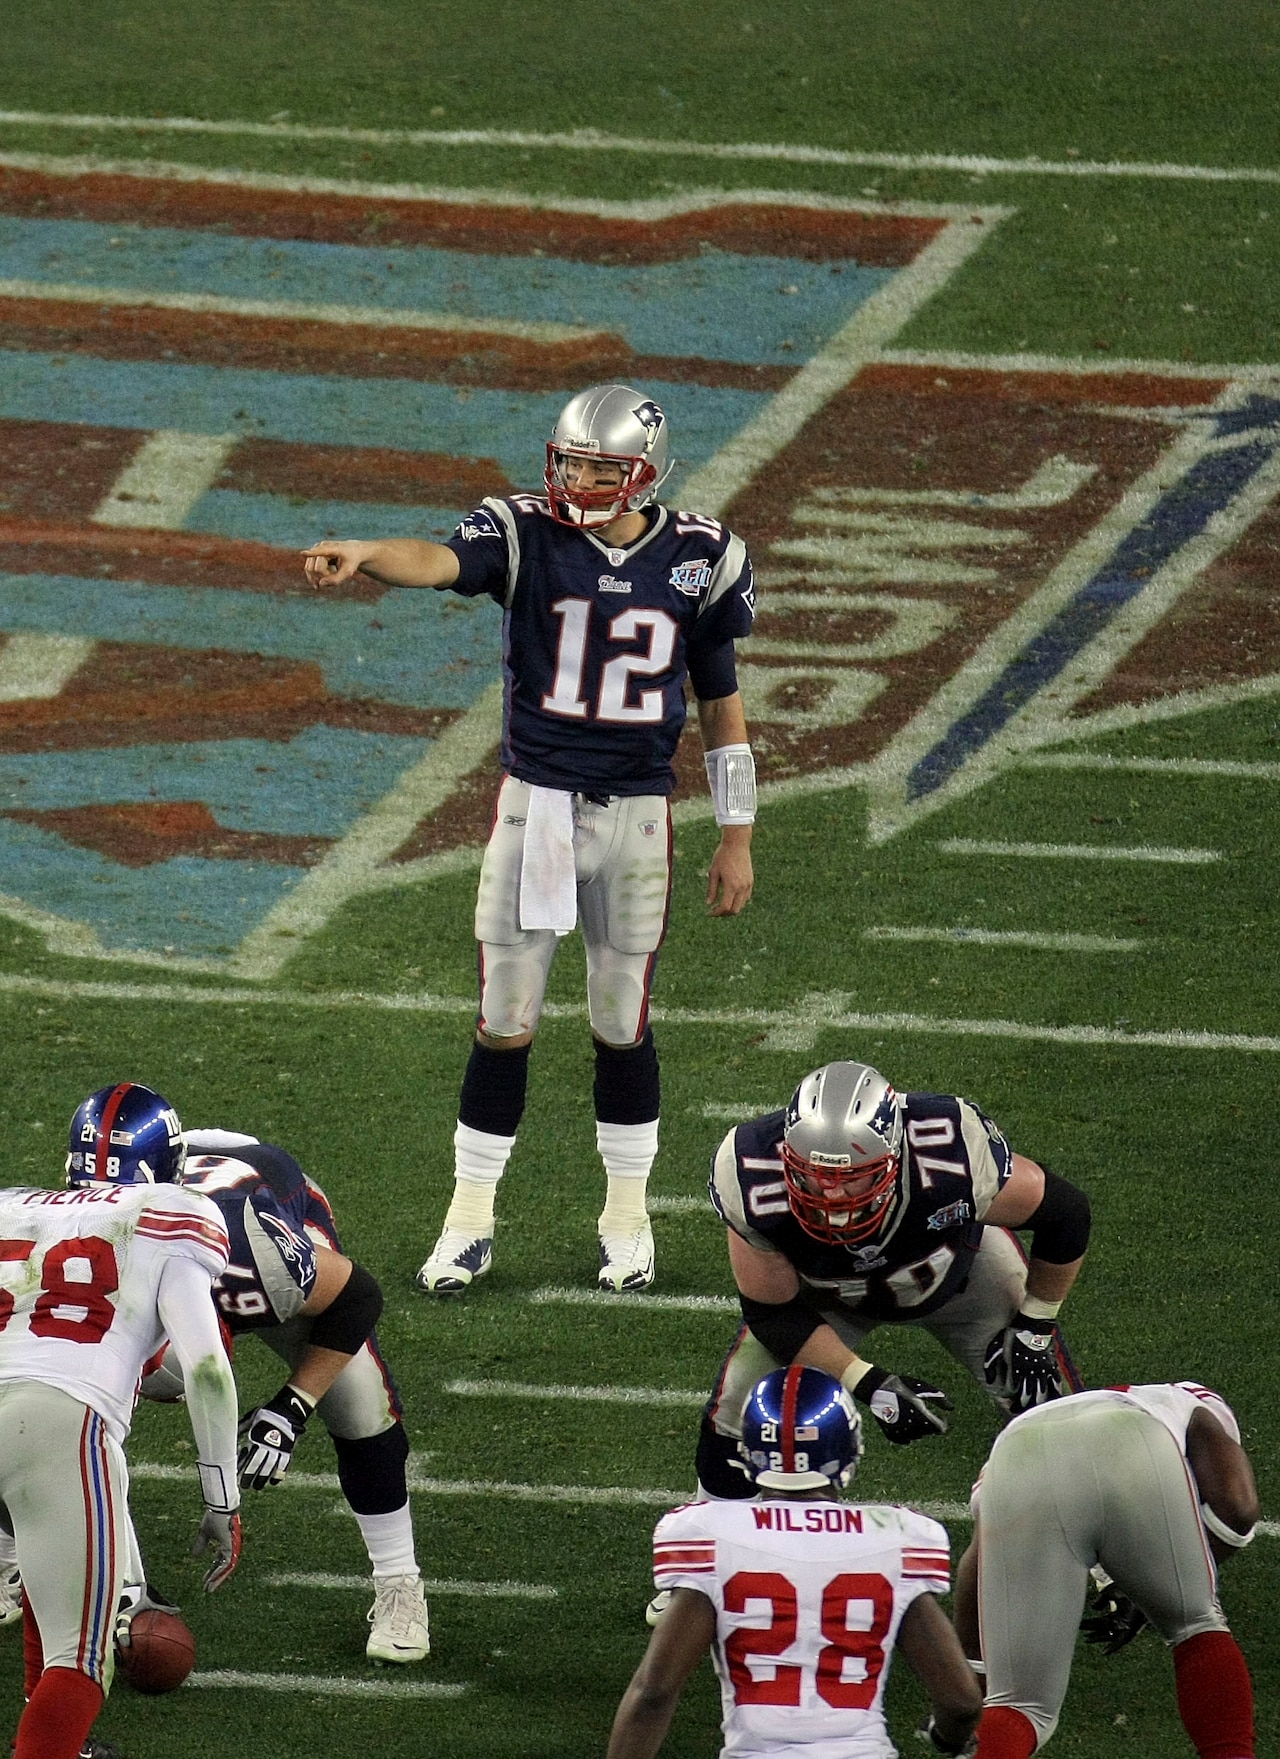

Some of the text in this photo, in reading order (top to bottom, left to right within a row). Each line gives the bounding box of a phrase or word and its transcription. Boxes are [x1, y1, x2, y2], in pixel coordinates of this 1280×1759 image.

[686, 452, 1104, 730] BOWL
[541, 598, 678, 724] 12
[80, 1123, 96, 1143] 21
[908, 1116, 968, 1190] 70
[22, 1184, 136, 1206] PIERCE
[761, 1422, 778, 1443] 21
[768, 1451, 810, 1473] 28
[751, 1507, 864, 1533] WILSON
[722, 1571, 895, 1710] 28
